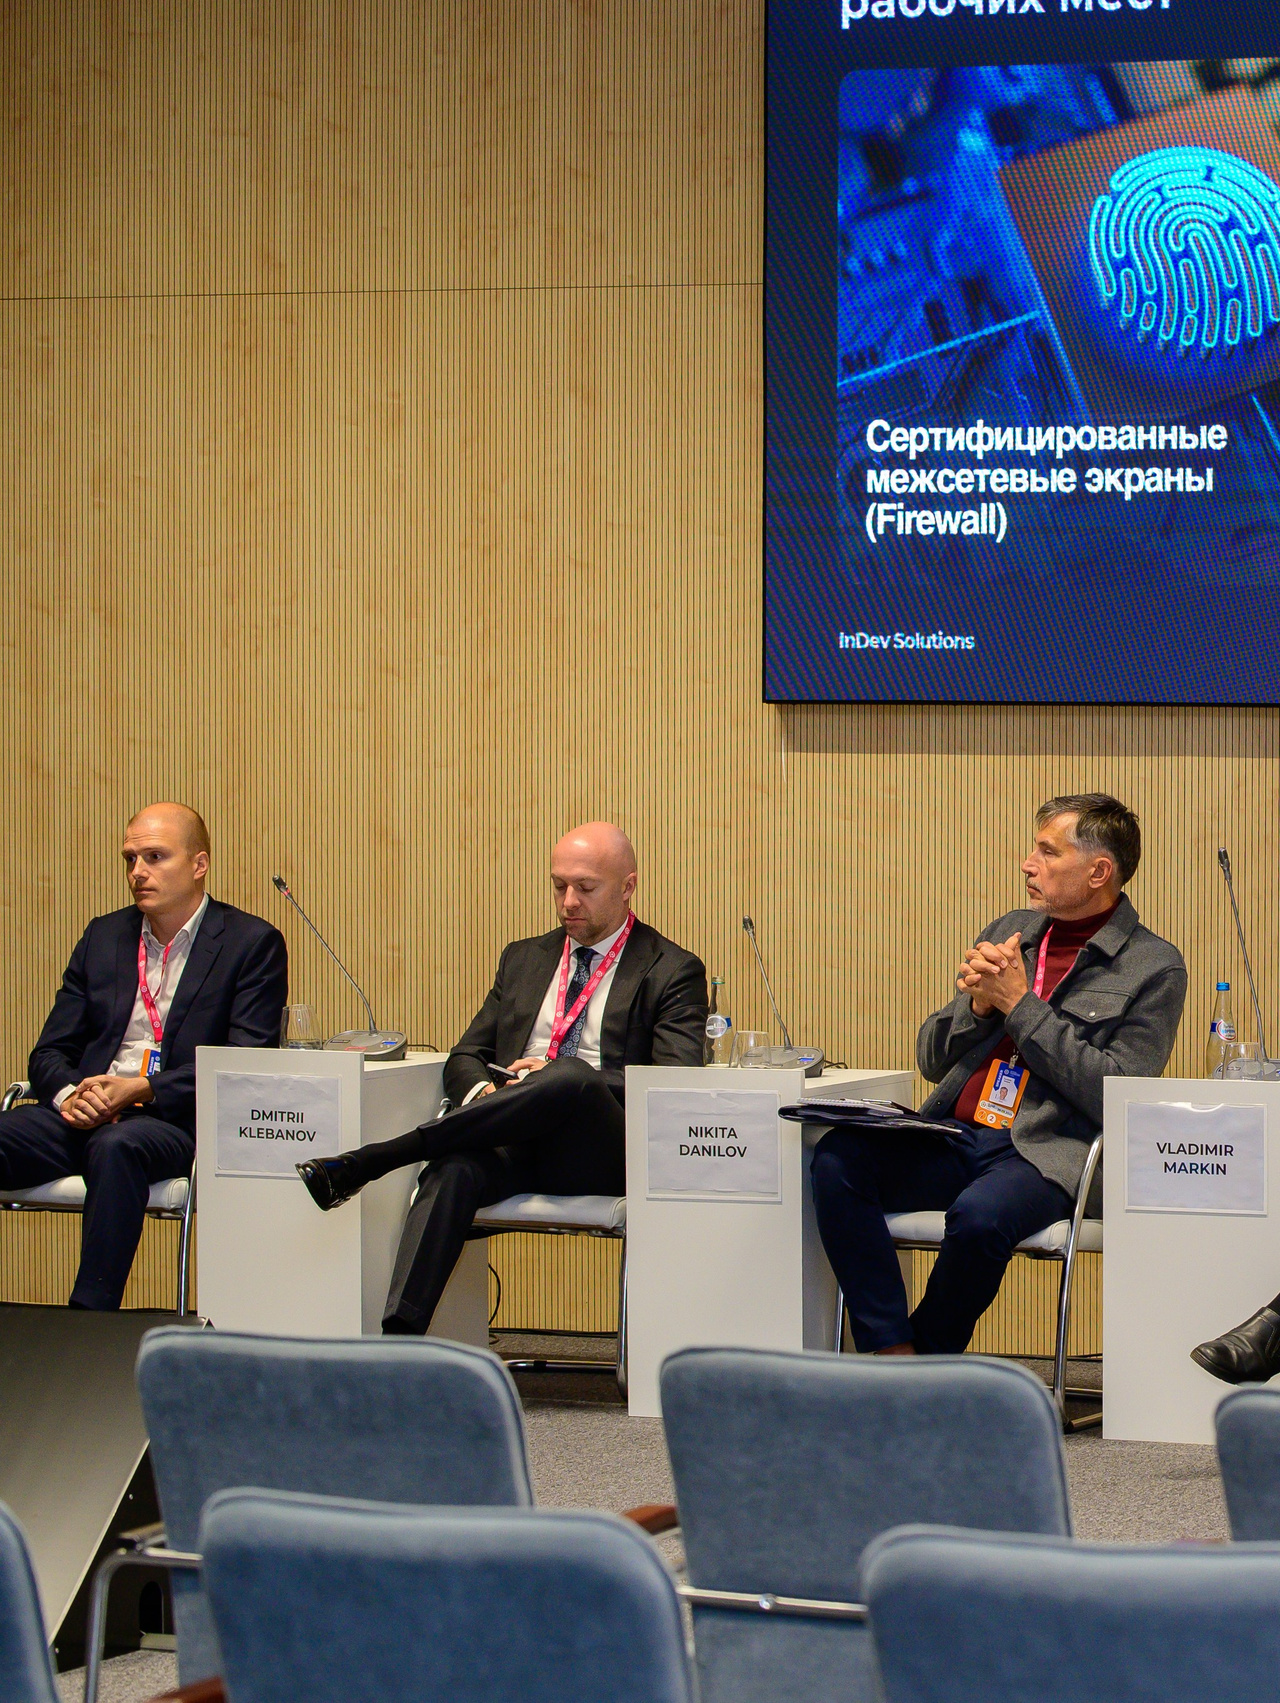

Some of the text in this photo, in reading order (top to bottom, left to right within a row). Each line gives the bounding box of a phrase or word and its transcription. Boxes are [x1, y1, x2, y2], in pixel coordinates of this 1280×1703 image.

[866, 419, 1228, 458] Сертифицированные
[866, 467, 1214, 501] межсетевые экраны
[865, 501, 1008, 543] (Firewall)
[893, 630, 975, 650] Solutions
[250, 1109, 304, 1123] DMITRII
[239, 1126, 316, 1142] KLEBANOV
[688, 1126, 738, 1139] NIKITA
[679, 1144, 747, 1158] DANILOV
[1156, 1142, 1234, 1157] VLADIMIR
[1164, 1161, 1227, 1176] MARKIN
